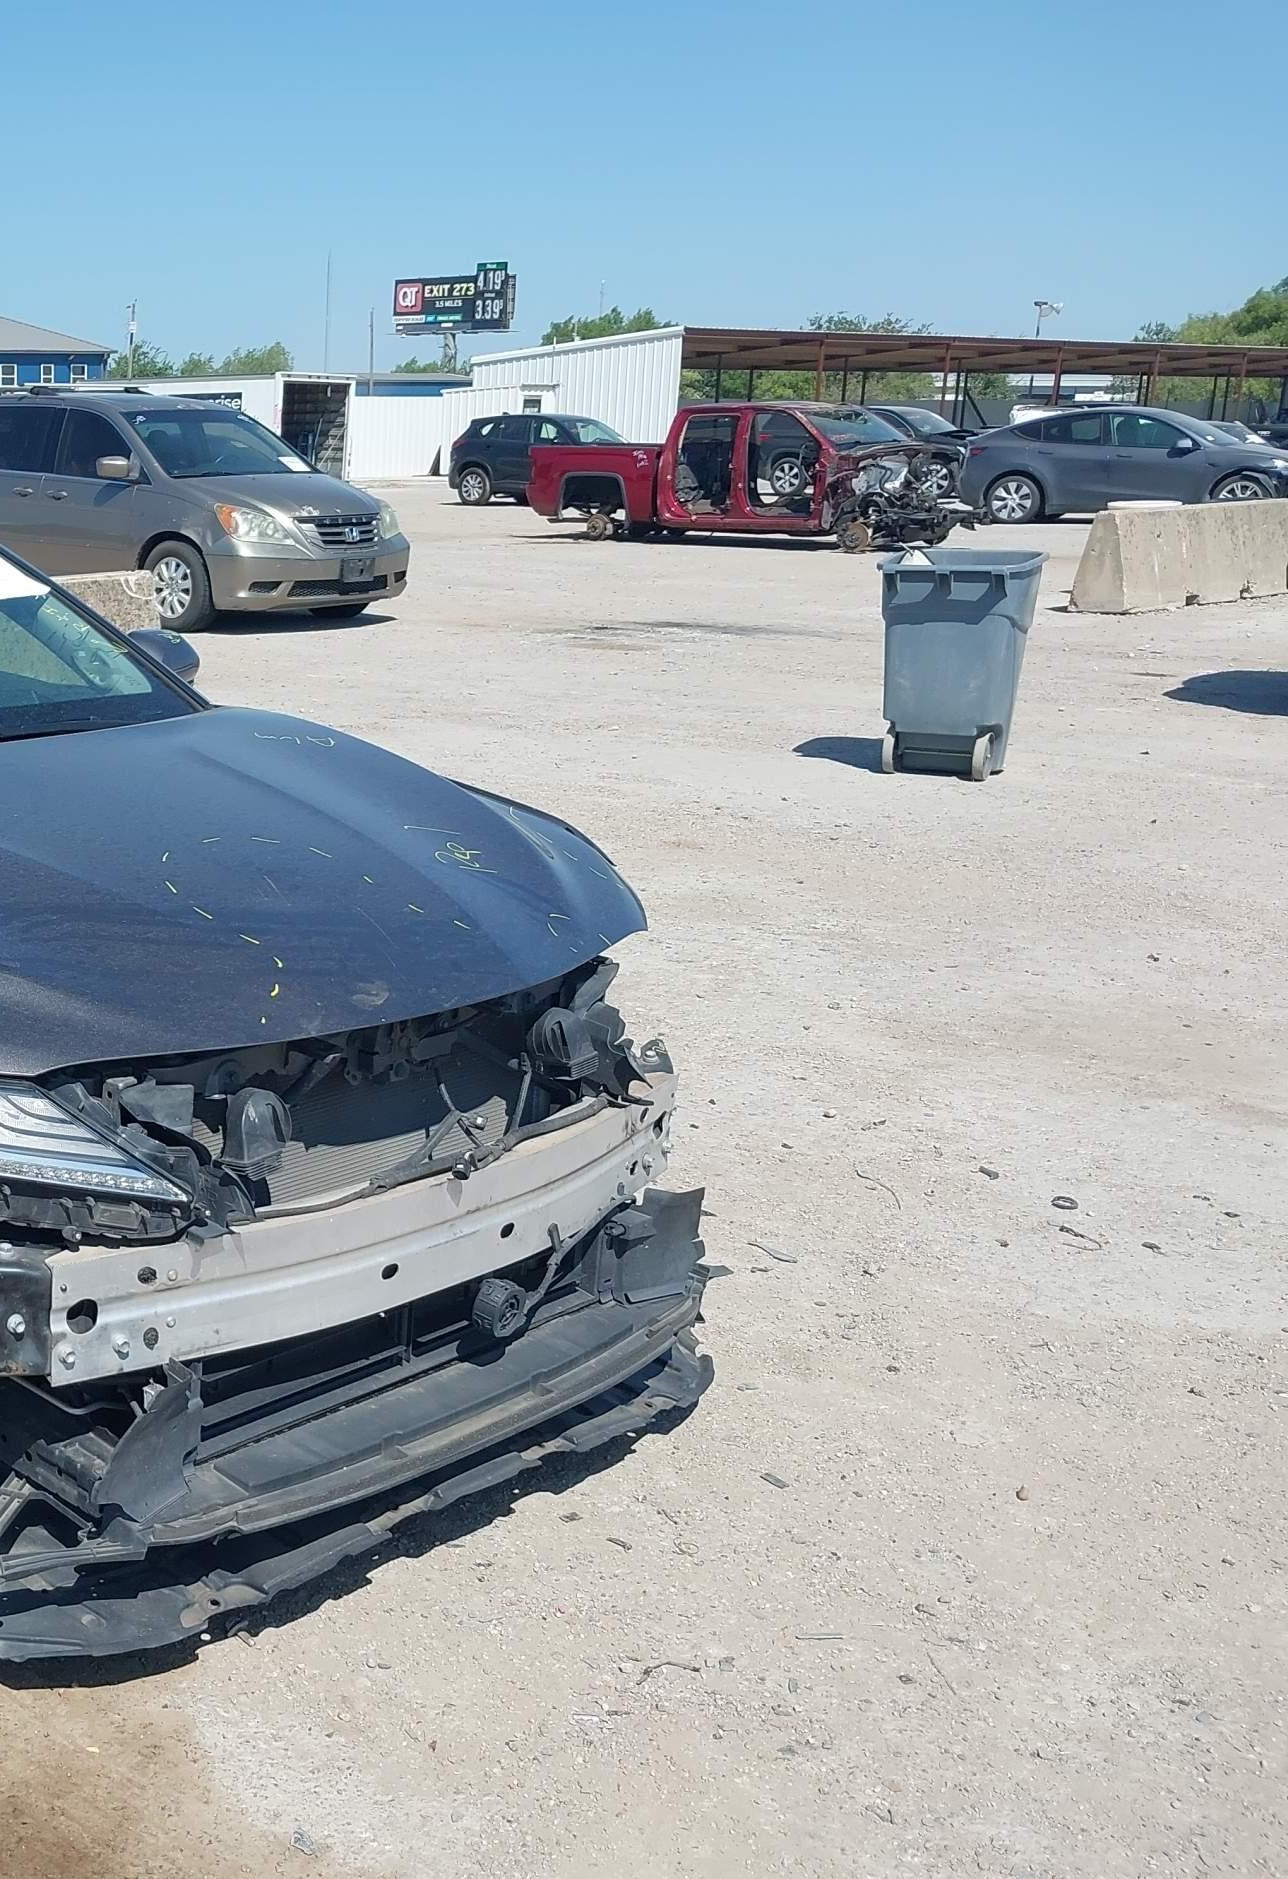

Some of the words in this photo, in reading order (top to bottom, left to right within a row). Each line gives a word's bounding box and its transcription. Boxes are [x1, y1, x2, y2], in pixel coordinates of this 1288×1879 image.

[398, 287, 418, 307] QT
[424, 285, 450, 297] EXIT
[452, 282, 475, 296] 273
